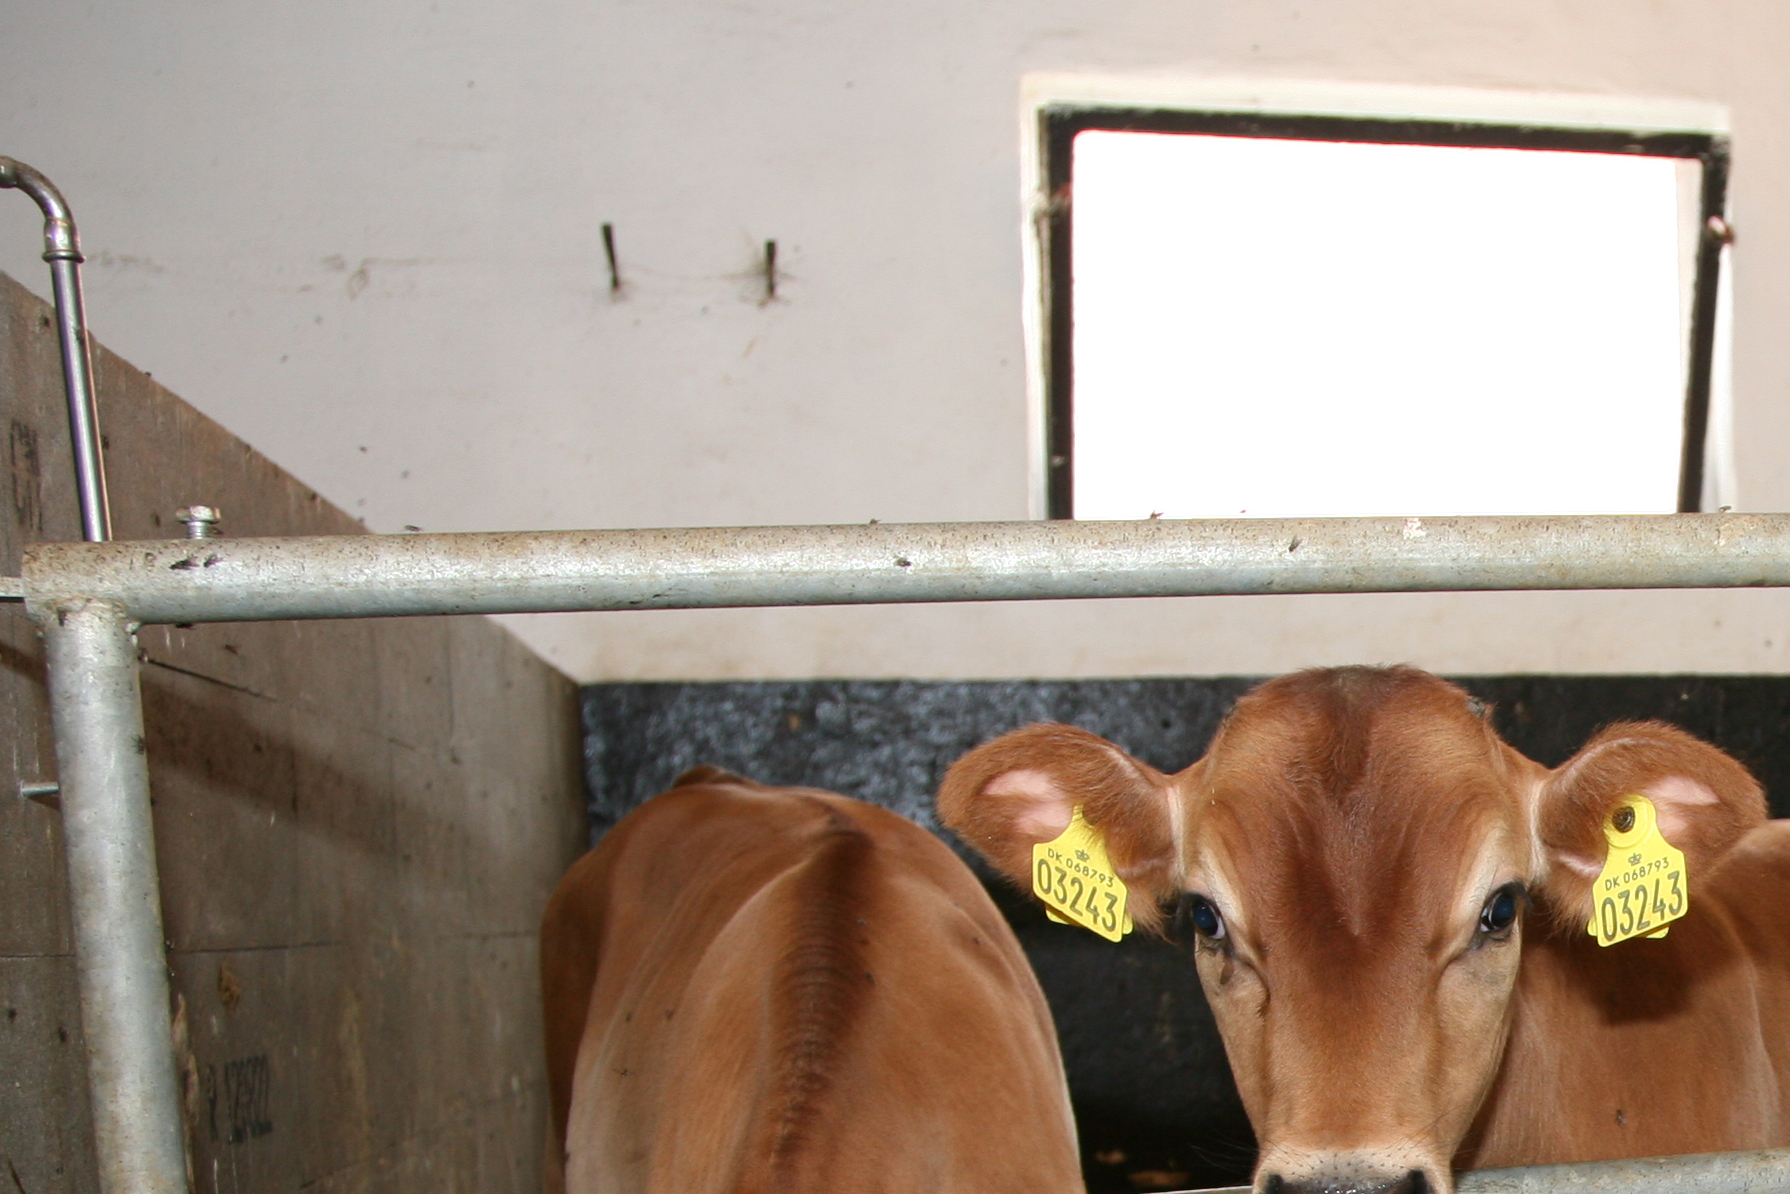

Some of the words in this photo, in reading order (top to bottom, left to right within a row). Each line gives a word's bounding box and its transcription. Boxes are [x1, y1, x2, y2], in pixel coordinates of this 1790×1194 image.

[1037, 858, 1118, 932] 03243
[1047, 848, 1063, 864] DK
[1066, 858, 1114, 888] 068793
[1604, 875, 1620, 891] DK
[1623, 856, 1670, 883] 068793
[1601, 870, 1683, 942] 03243
